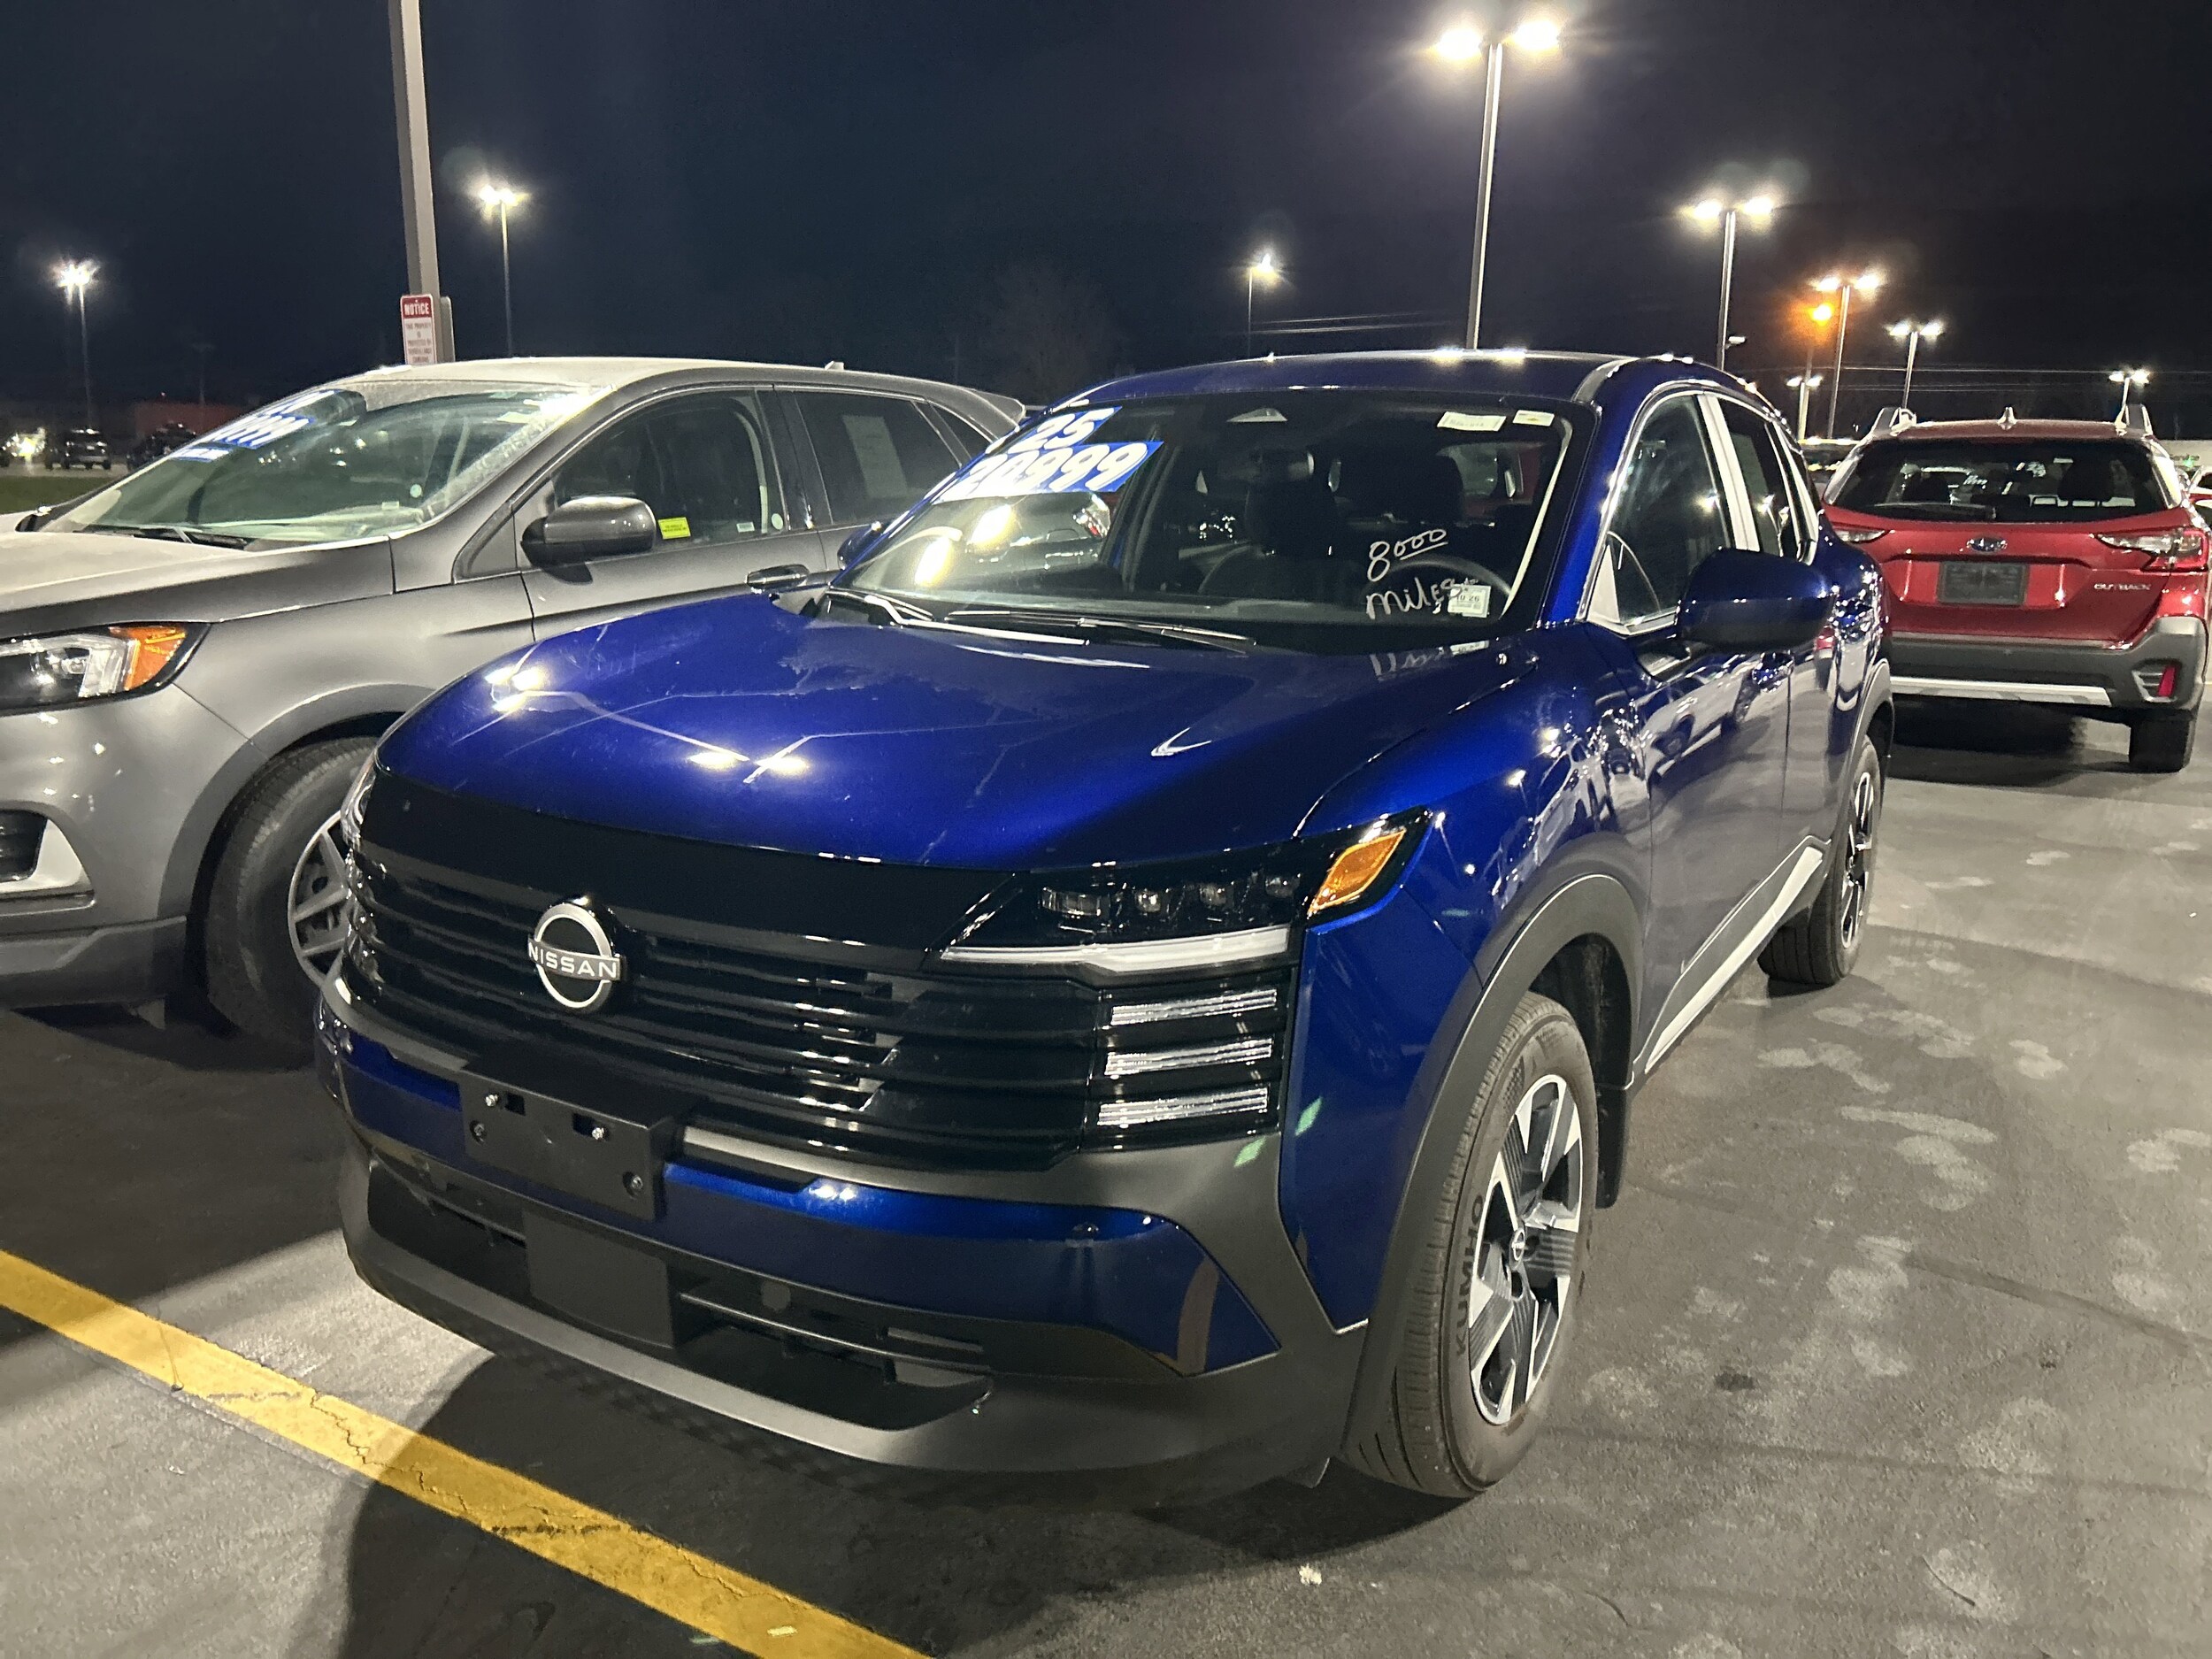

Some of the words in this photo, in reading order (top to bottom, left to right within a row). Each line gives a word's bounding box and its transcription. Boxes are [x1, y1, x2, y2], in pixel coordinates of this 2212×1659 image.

[403, 303, 430, 316] NOTICE
[1007, 407, 1115, 455] 25
[1366, 528, 1448, 582] 8000
[528, 941, 618, 979] NISSAN
[1455, 1194, 1484, 1356] KUMHO
